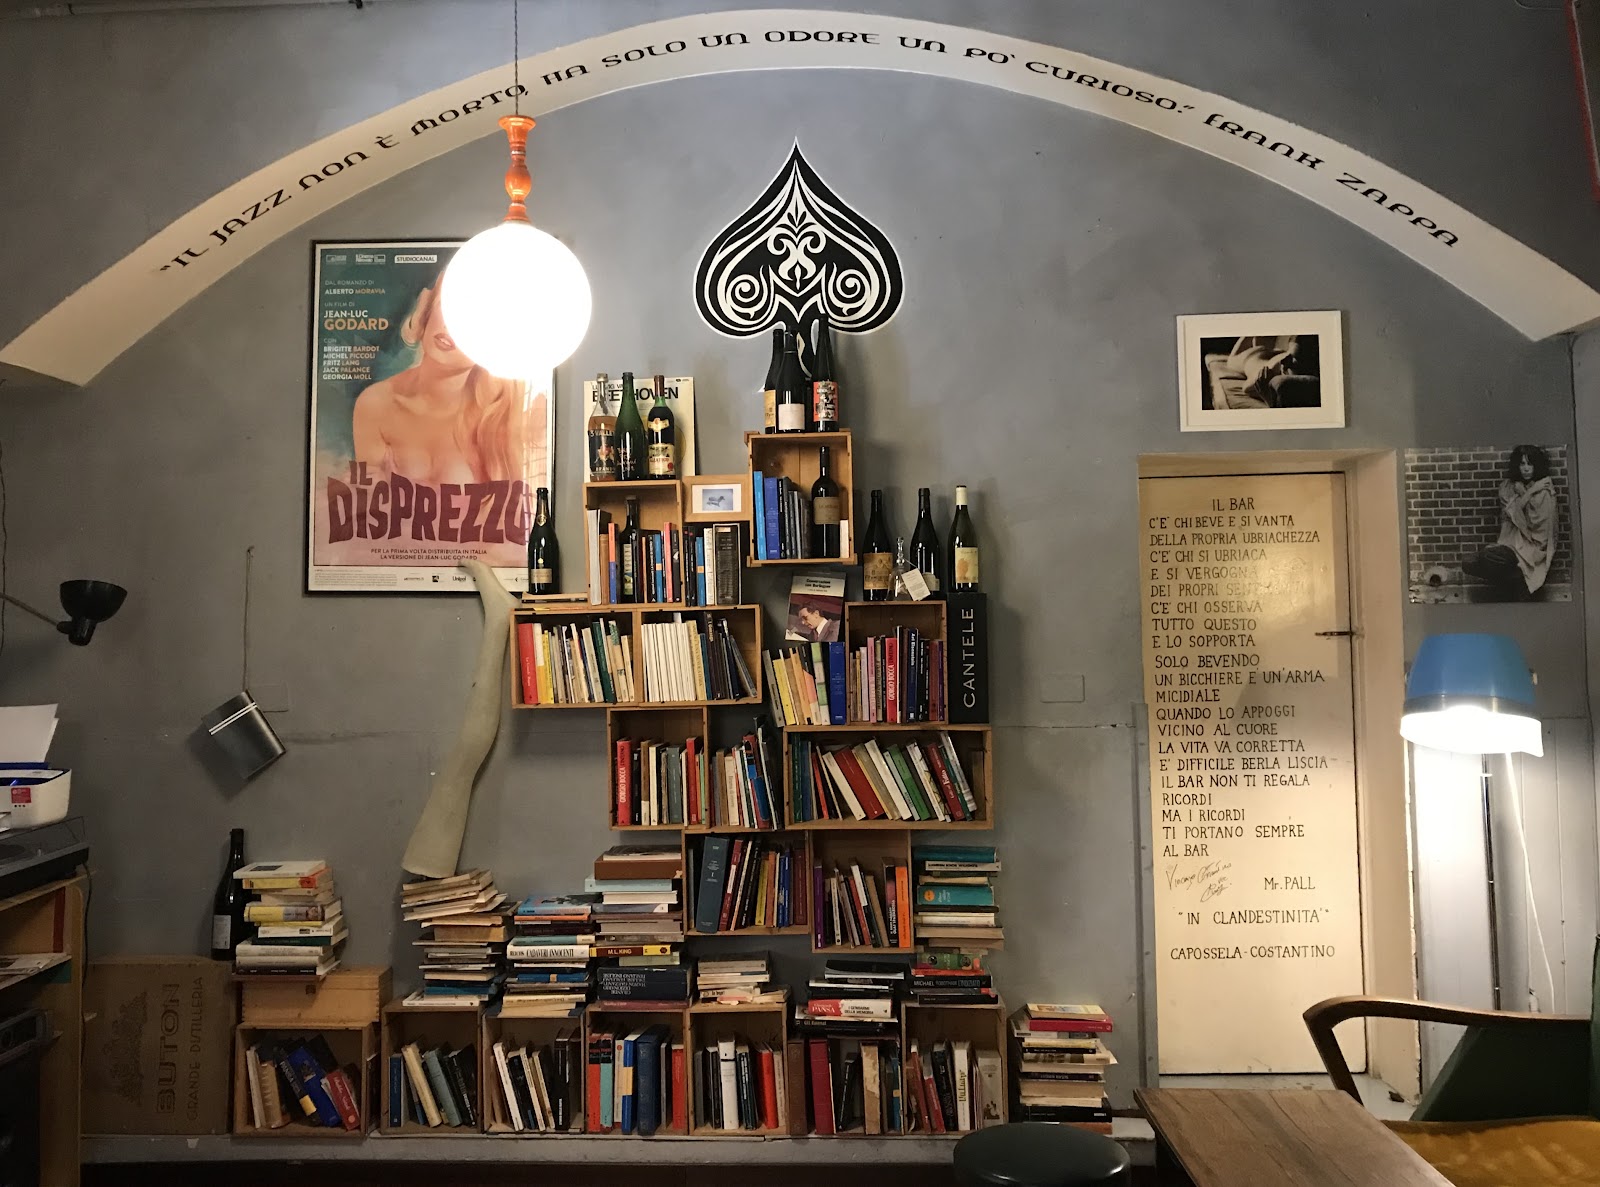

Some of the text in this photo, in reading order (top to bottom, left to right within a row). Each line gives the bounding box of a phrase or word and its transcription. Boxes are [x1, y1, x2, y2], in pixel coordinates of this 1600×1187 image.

[209, 189, 292, 246] JAZZ
[298, 151, 371, 191] NON
[410, 84, 529, 136] MORTO,
[540, 64, 590, 85] HA
[601, 40, 687, 67] SOLO
[698, 32, 750, 48] UN
[764, 30, 881, 45] ODORE
[898, 36, 948, 53] UN
[1202, 113, 1325, 170] FRANK
[1335, 172, 1459, 247] ZAPPA
[324, 310, 368, 318] JEAN-LUC
[324, 318, 389, 331] GODARD
[349, 461, 372, 486] IL
[327, 472, 531, 546] DISPREZZO
[1212, 497, 1255, 511] IL BAR
[1174, 516, 1192, 528] CHI
[1195, 515, 1224, 528] BEVE
[1229, 515, 1236, 527] E
[1240, 515, 1250, 527] SI
[1255, 514, 1295, 527] VANTA
[1150, 531, 1320, 546] DELLA PROPRIA UBRIACHEZZA
[1175, 551, 1193, 563] CHI
[1199, 550, 1208, 562] SI
[1215, 549, 1267, 562] UBRIACA
[1150, 566, 1259, 580] E SI VERGOGNA
[1150, 584, 1171, 597] DEI
[1179, 583, 1219, 597] PROPRI
[1177, 602, 1197, 614] CHI
[1204, 601, 1263, 613] OSSERVA
[1151, 618, 1257, 631] TUTTO QUESTO
[1152, 635, 1256, 648] E LO SOPPORTA
[961, 608, 977, 708] CANTELE
[1155, 654, 1260, 668] SOLO BEVENDO
[1155, 674, 1173, 686] UN
[1179, 671, 1242, 686] BICCHIERE
[1156, 689, 1221, 702] MICIDIALE
[1156, 705, 1296, 721] QUANDO LO APPOGGI
[1157, 723, 1278, 737] VICINO AL CUORE
[1158, 739, 1305, 754] LA VITA VA CORRETTA
[1177, 758, 1235, 771] DIFFICILE
[1242, 757, 1281, 770] BERLA
[1288, 756, 1328, 769] LISCIA
[1161, 774, 1310, 789] IL BAR NON TI REGALA
[1162, 793, 1212, 806] RICORDI
[1162, 809, 1245, 822] MA I RICORDI
[1163, 825, 1305, 839] TI PORTANO SEMPRE
[1163, 844, 1209, 857] AL BAR
[526, 945, 549, 957] CADAVERI
[549, 945, 574, 957] INNOCENTI
[157, 984, 179, 1113] BUTON
[187, 1063, 200, 1121] GRANDE
